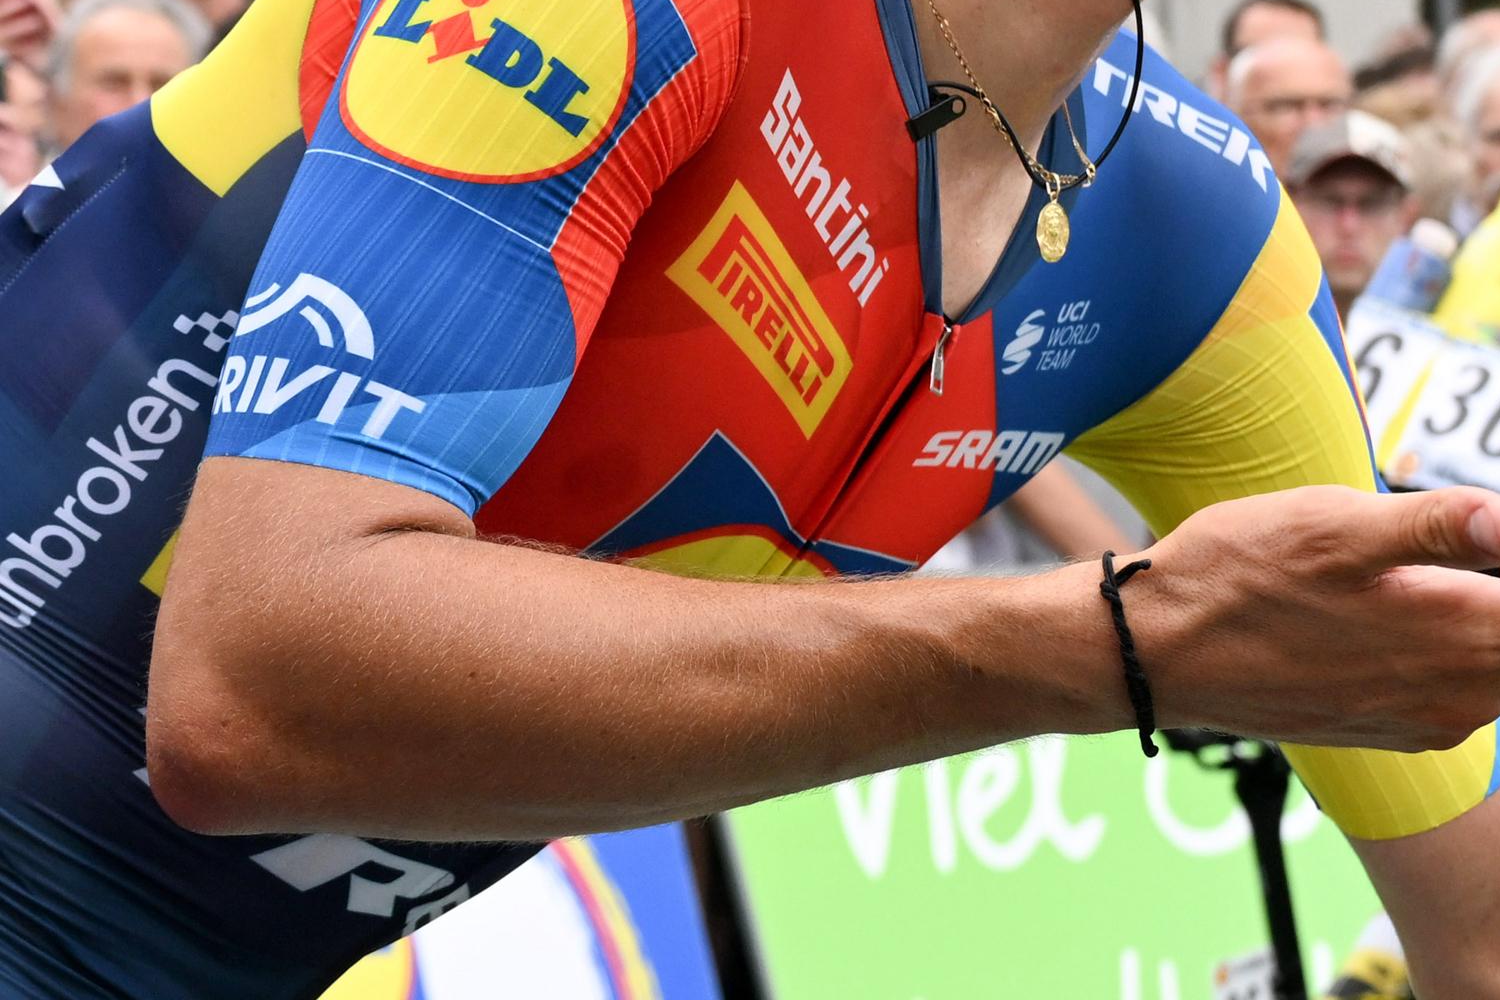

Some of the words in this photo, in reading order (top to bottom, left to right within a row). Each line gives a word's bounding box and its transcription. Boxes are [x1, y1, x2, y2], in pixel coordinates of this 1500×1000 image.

[1093, 57, 1273, 194] TREK
[760, 68, 890, 309] Santini
[696, 212, 835, 408] PIRELLI
[1046, 322, 1100, 349] WORLD
[1057, 300, 1091, 324] UCI
[1035, 347, 1077, 372] TEAM
[211, 354, 428, 440] RIVIT
[911, 429, 1066, 475] SRAM
